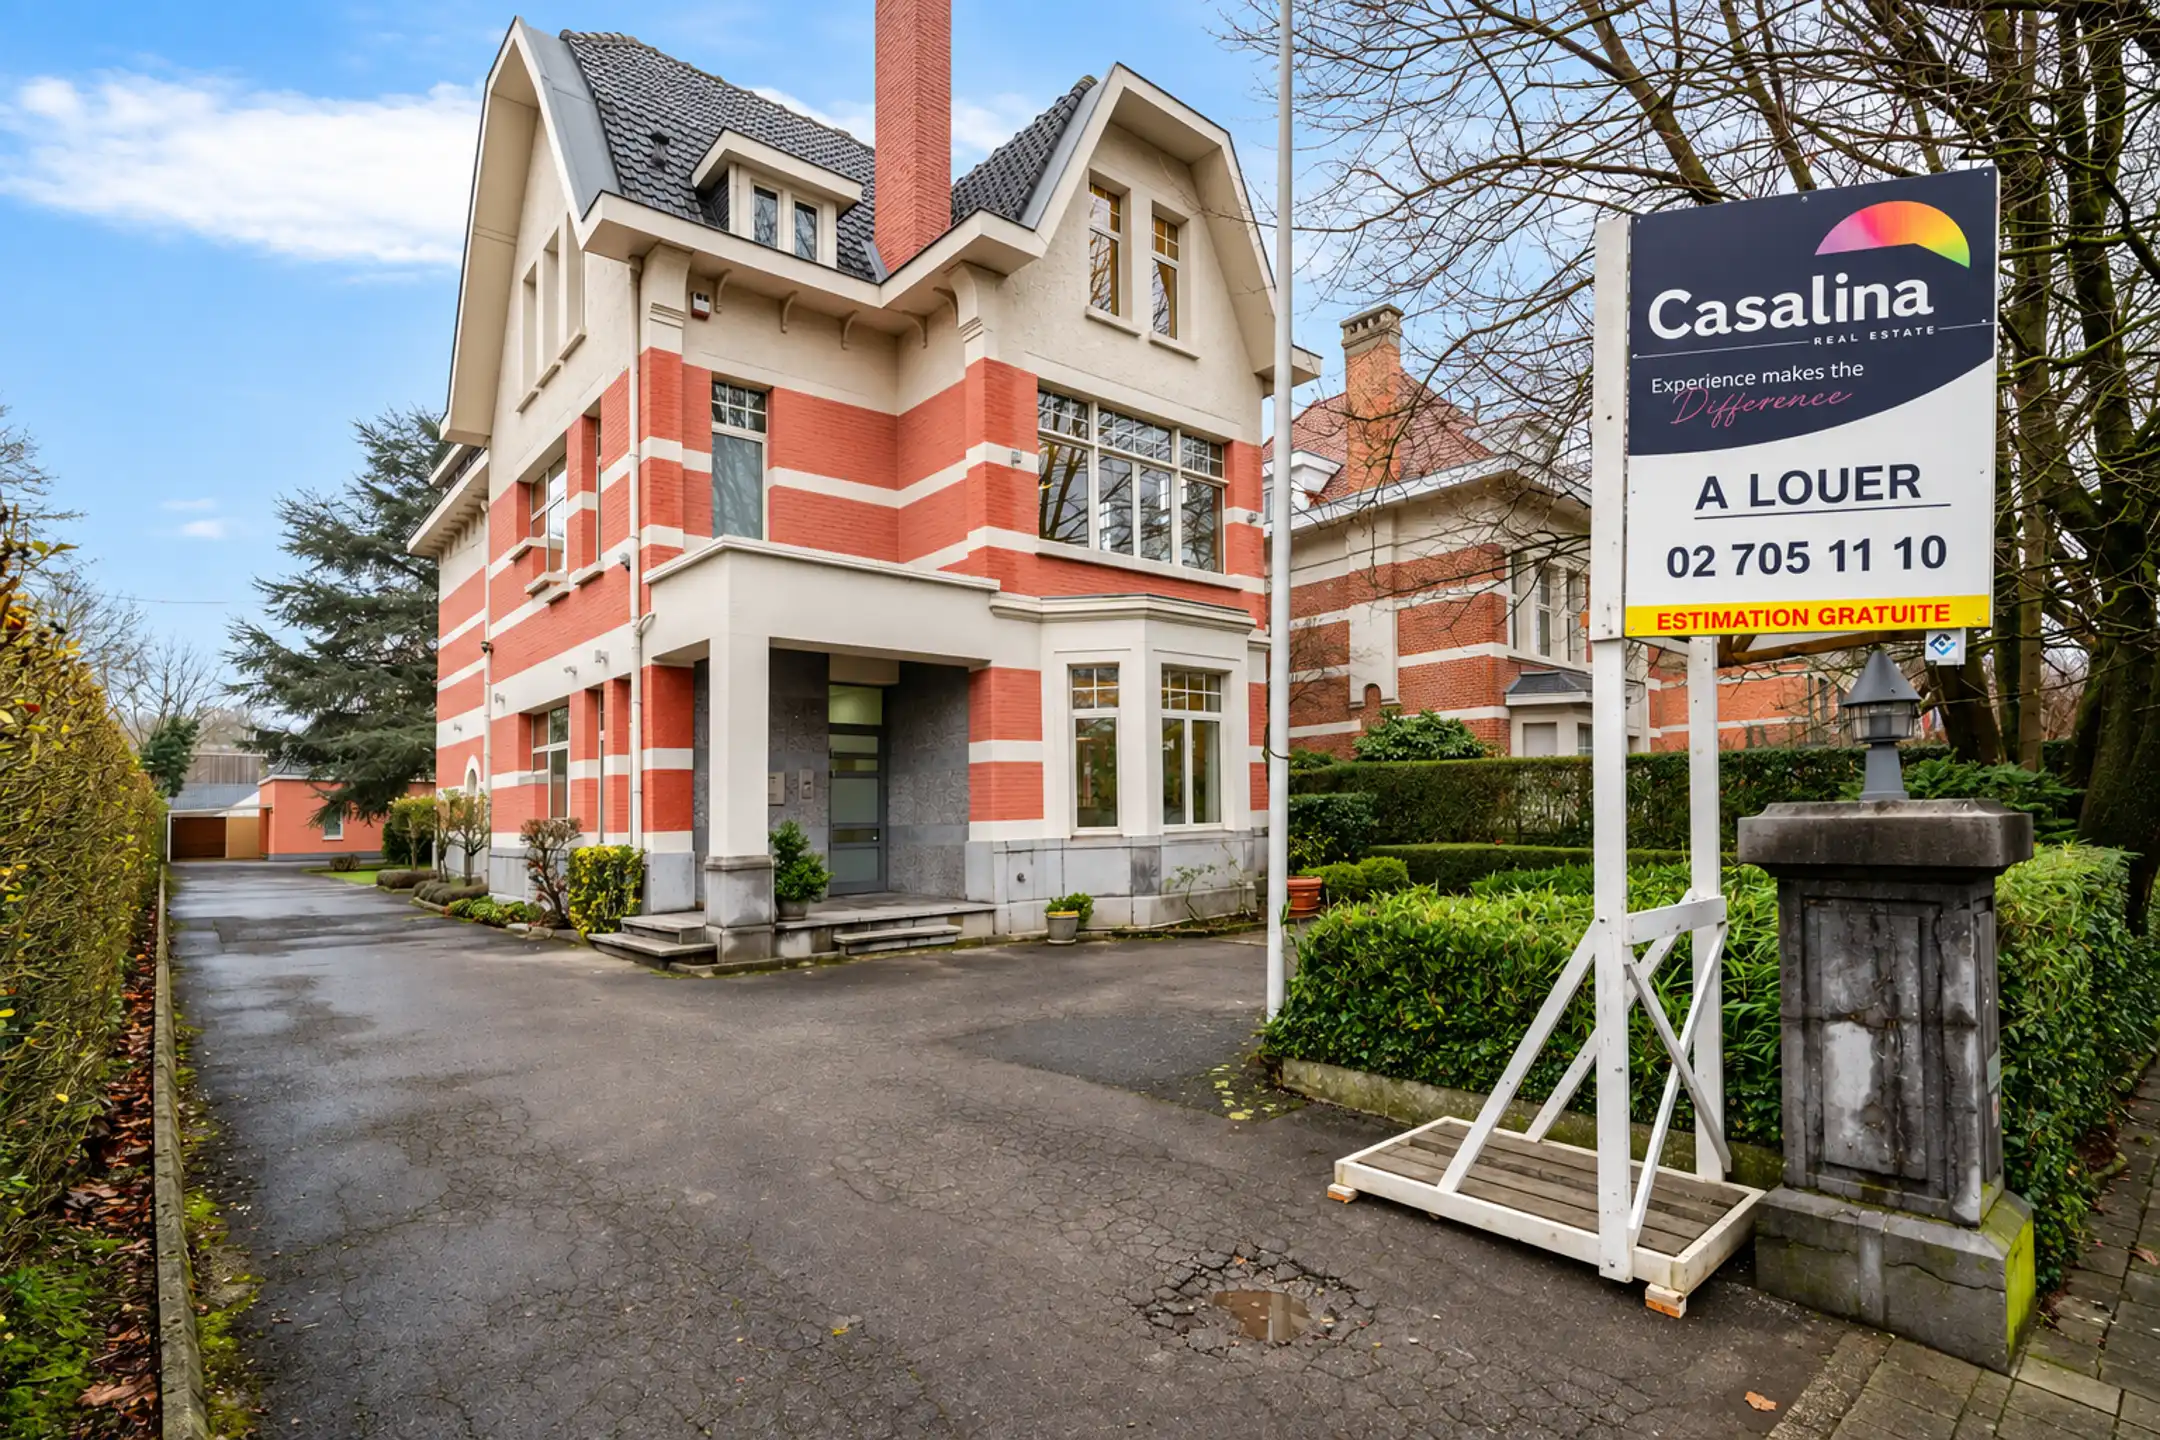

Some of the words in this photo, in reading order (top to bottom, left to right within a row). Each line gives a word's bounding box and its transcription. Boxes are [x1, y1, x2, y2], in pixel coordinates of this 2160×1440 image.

[1648, 273, 1934, 340] Casalina
[1814, 334, 1858, 346] REAL
[1870, 326, 1935, 340] ESTATE
[1652, 372, 1756, 394] Experience
[1762, 365, 1825, 384] makes
[1830, 361, 1864, 378] the
[1671, 387, 1853, 428] Difference
[1695, 476, 1728, 510] A
[1750, 463, 1921, 507] LOUER
[1667, 545, 1716, 578] 02
[1731, 541, 1810, 575] 705
[1829, 538, 1870, 572] 11
[1894, 535, 1947, 569] 10
[1657, 608, 1809, 630] ESTIMATION
[1818, 604, 1950, 625] GRATUITE
